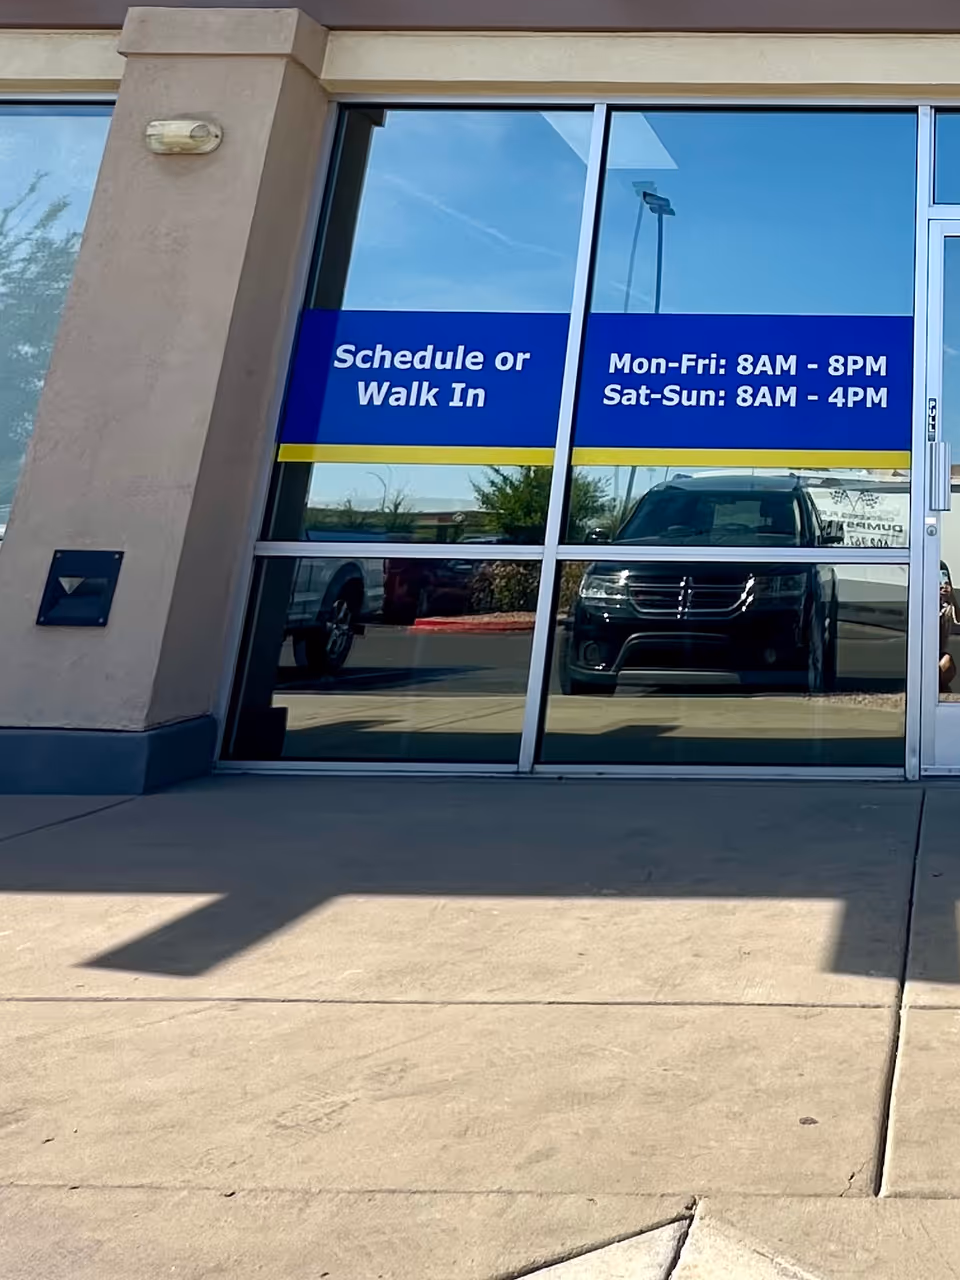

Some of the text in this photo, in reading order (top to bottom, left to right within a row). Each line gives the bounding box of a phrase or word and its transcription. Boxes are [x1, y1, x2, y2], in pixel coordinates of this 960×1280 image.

[333, 344, 531, 371] Schedule or
[608, 353, 726, 375] Mon-Fri:
[736, 354, 797, 376] 8AM
[828, 355, 887, 377] 8PM
[357, 381, 486, 408] Walk In
[603, 383, 726, 407] Sat-Sun:
[736, 385, 797, 407] 8AM
[828, 386, 888, 408] 4PM
